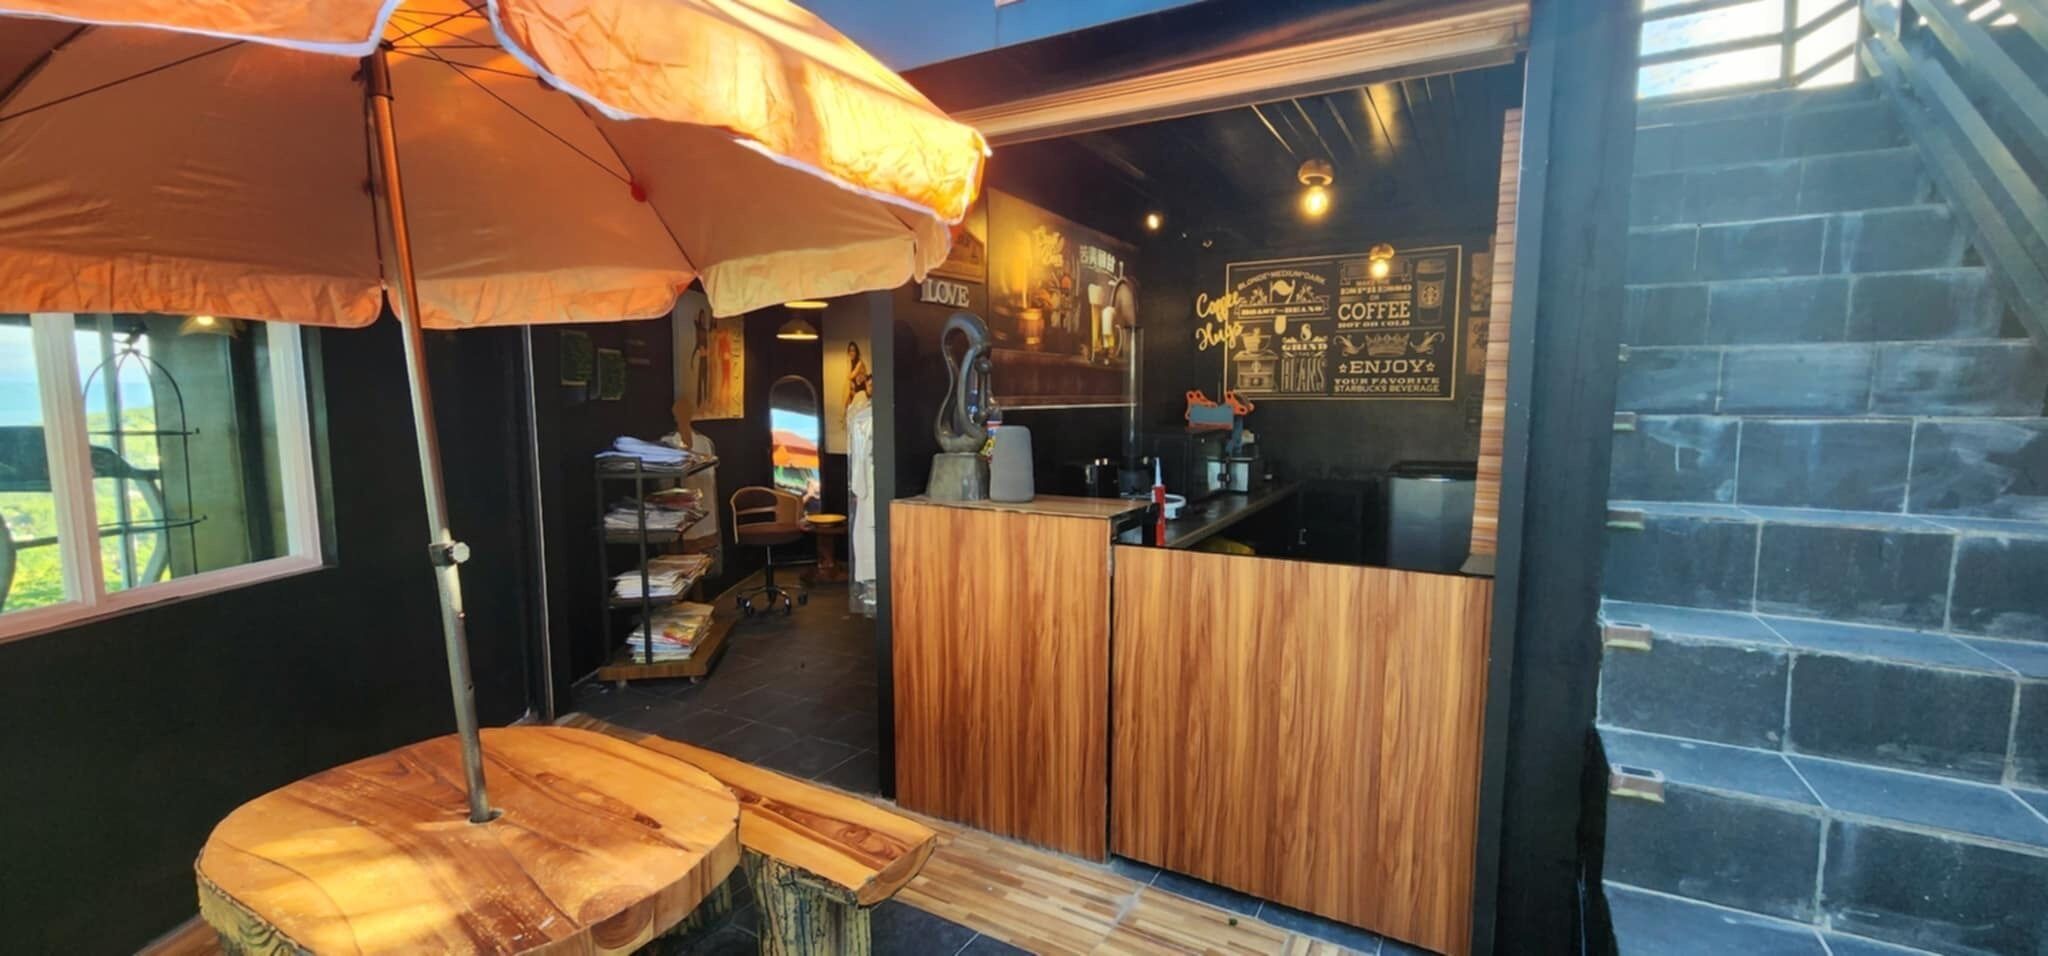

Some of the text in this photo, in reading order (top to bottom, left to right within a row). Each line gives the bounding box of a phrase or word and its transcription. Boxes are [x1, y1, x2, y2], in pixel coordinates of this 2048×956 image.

[923, 279, 970, 308] LOVE
[1340, 284, 1412, 295] ESPRESSO
[1196, 291, 1240, 322] Coffee
[1338, 302, 1411, 320] COFFEE
[1196, 321, 1243, 351] Hugs
[1281, 343, 1328, 351] GRIND
[1349, 360, 1426, 374] ENJOY
[1334, 384, 1440, 393] STARBUCKS BEVERAGE
